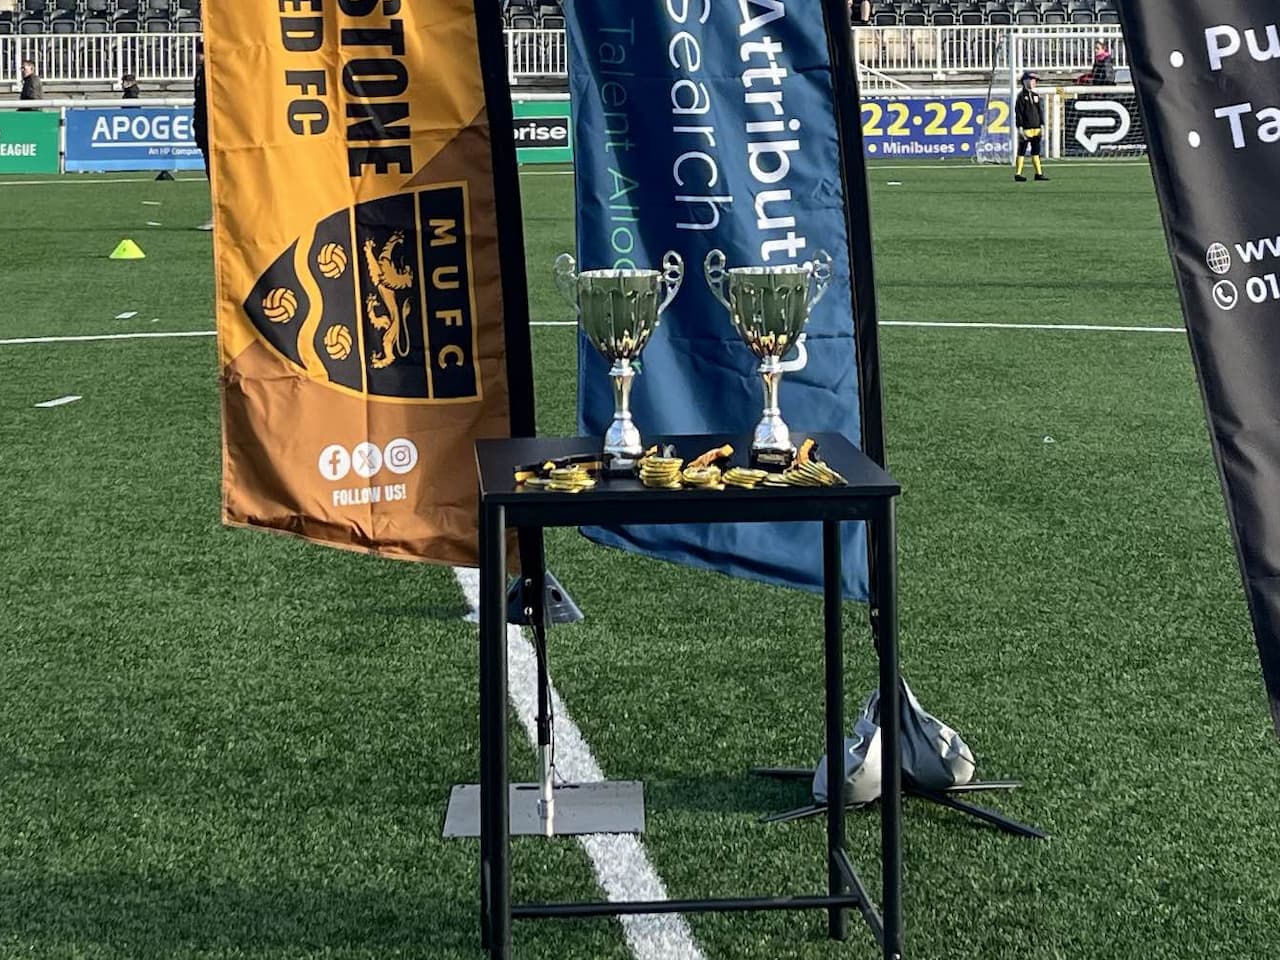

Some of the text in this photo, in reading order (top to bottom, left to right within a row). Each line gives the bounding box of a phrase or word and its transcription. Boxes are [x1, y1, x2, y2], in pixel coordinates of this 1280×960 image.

[285, 70, 330, 135] FC
[599, 17, 635, 152] Talent
[91, 116, 196, 140] APOGE
[883, 141, 955, 154] Minibuses
[428, 218, 465, 369] MUFC
[332, 483, 407, 506] FOLLOW US!
